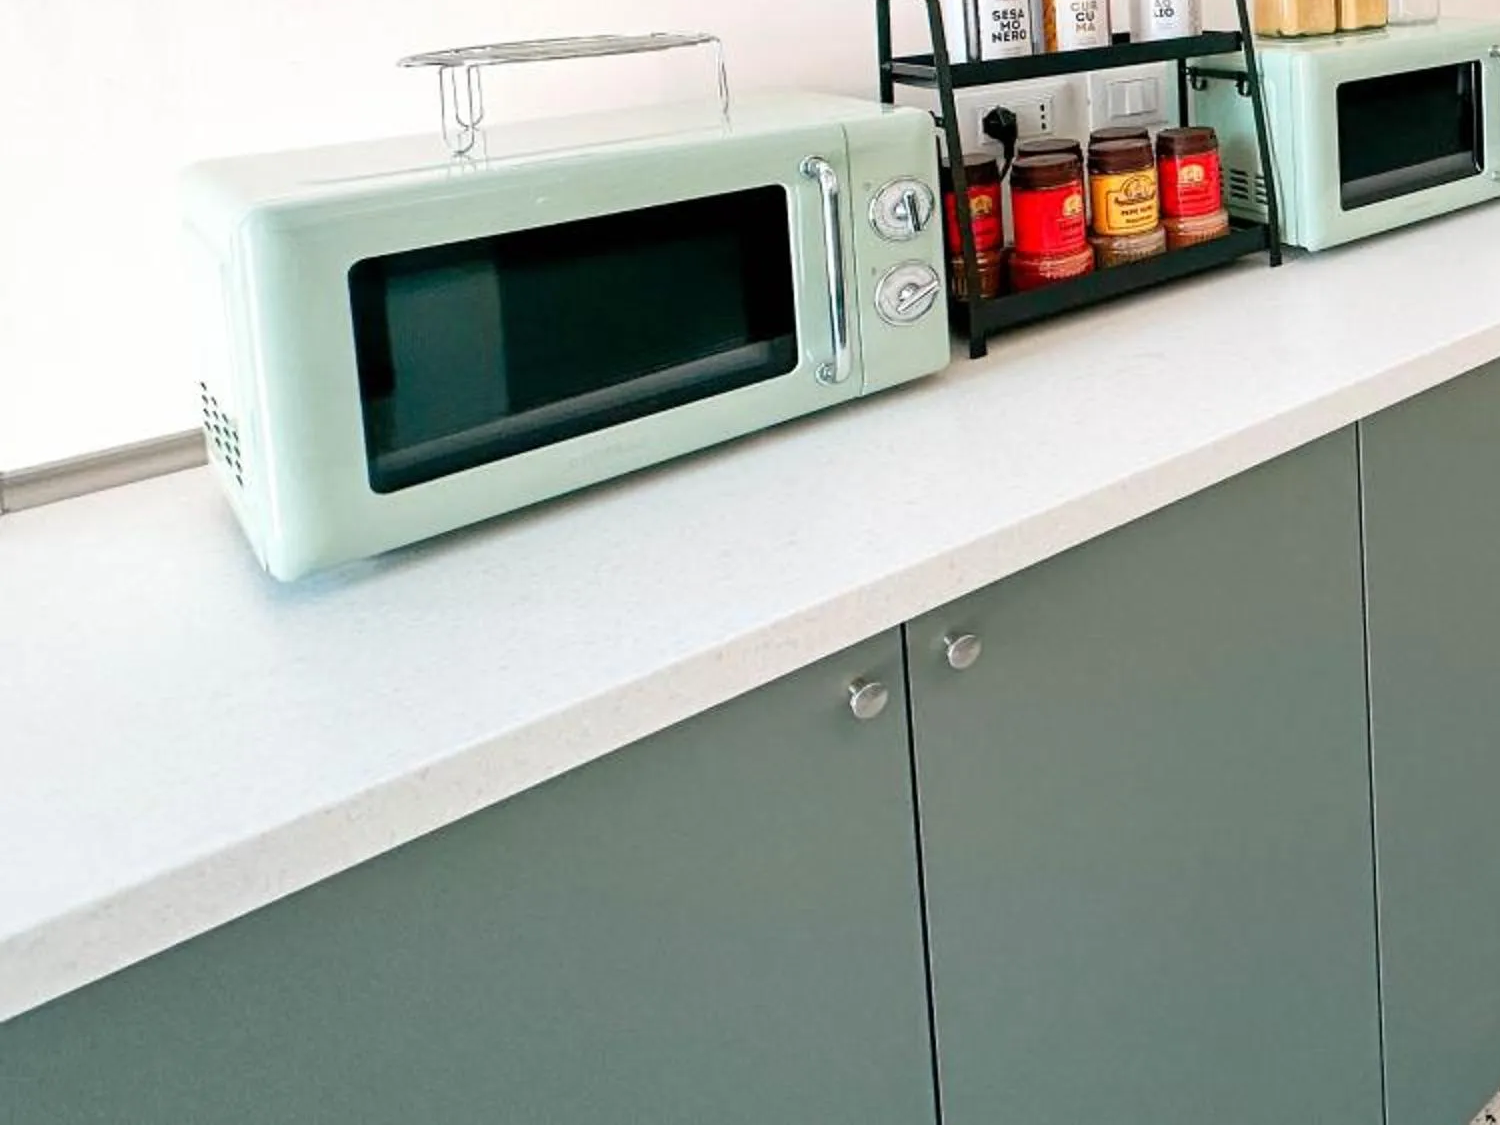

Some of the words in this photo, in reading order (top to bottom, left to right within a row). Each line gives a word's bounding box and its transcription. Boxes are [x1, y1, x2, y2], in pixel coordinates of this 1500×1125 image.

[991, 8, 1025, 22] SESA
[1075, 11, 1095, 23] CU
[1000, 20, 1021, 31] MO
[991, 29, 1027, 43] NERO
